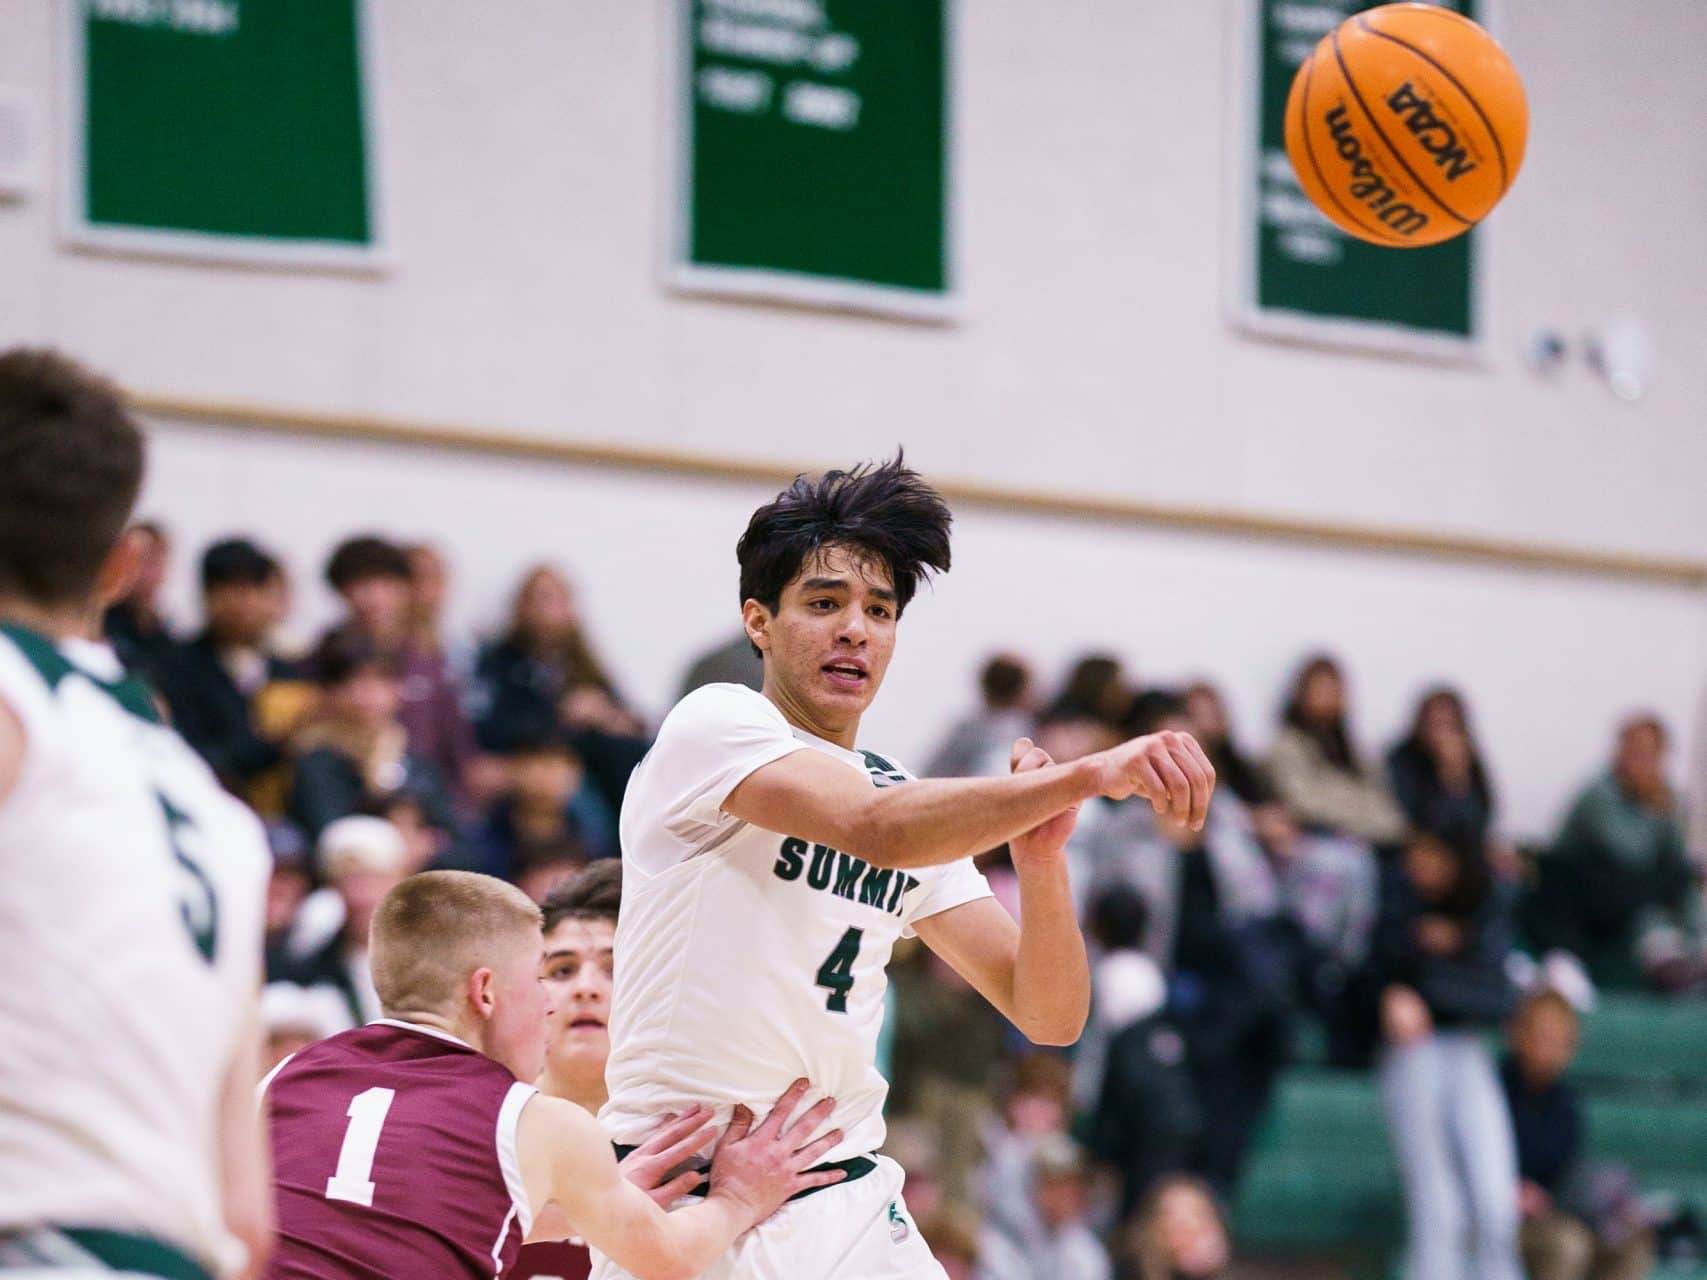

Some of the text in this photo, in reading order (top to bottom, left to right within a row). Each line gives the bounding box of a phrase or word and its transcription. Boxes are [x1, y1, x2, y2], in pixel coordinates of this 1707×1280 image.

[1324, 103, 1430, 236] Wilson
[1387, 81, 1476, 182] NCAA
[152, 791, 218, 965] 5
[815, 925, 865, 1016] 4
[325, 1085, 396, 1208] 1
